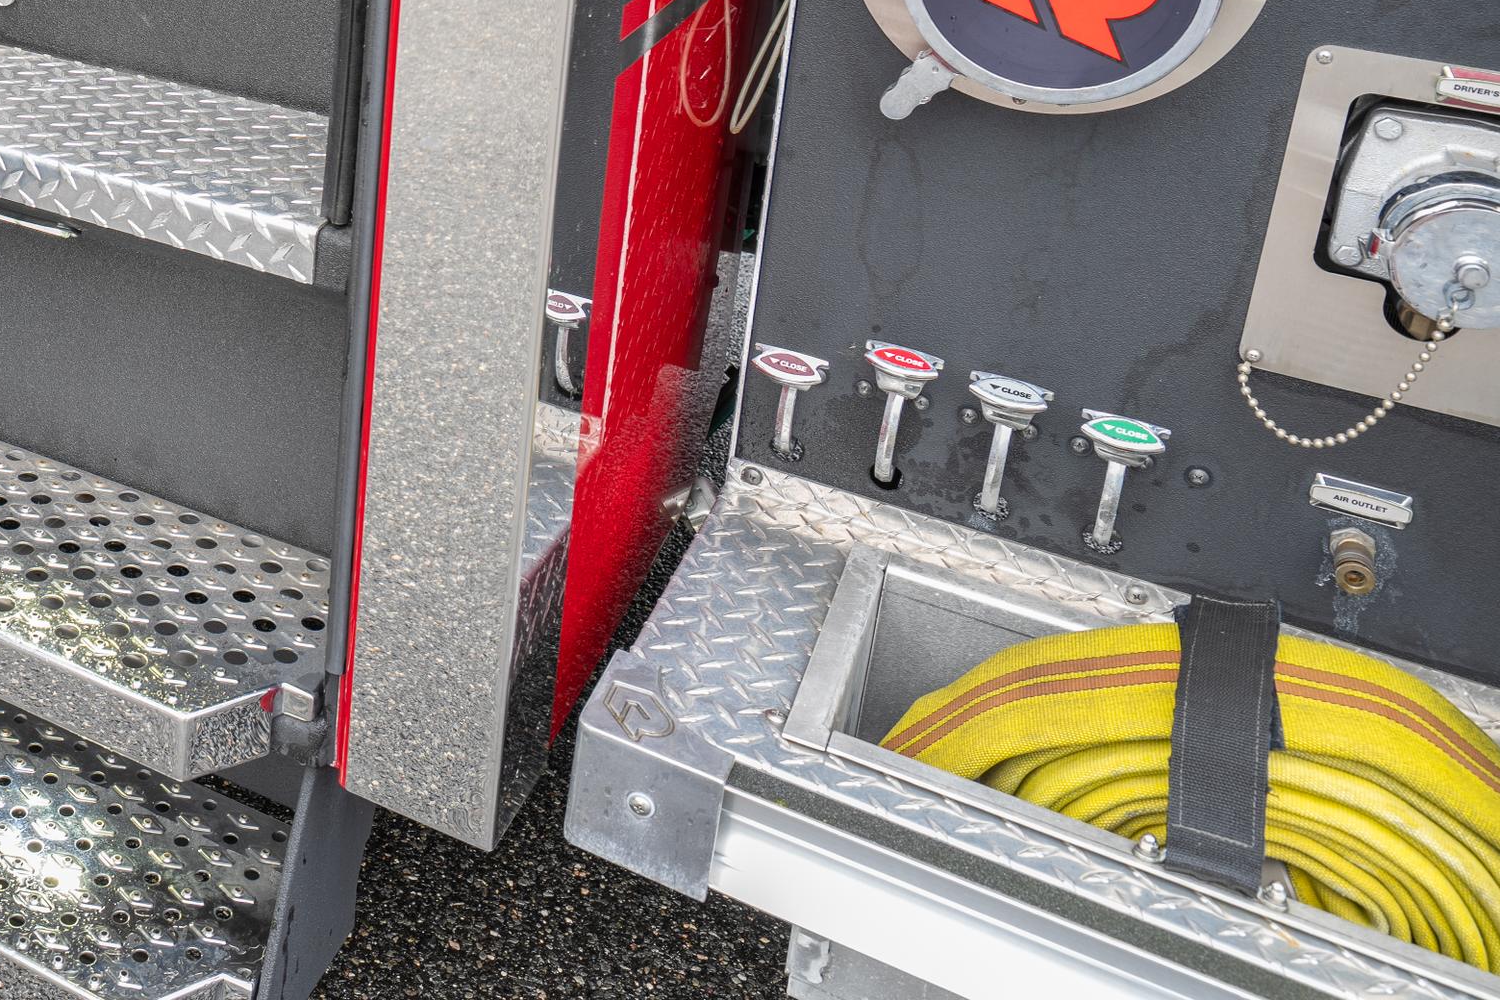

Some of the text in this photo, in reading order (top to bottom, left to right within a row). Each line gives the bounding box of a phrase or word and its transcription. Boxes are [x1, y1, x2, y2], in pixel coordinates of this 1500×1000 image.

[1453, 84, 1500, 98] DRIVER'S
[779, 359, 808, 373] CLOSE
[894, 354, 925, 368] CLOSE
[1001, 386, 1033, 400] CLOSE
[1115, 426, 1149, 441] CLOSE
[1332, 494, 1388, 513] AIR OUTLET
